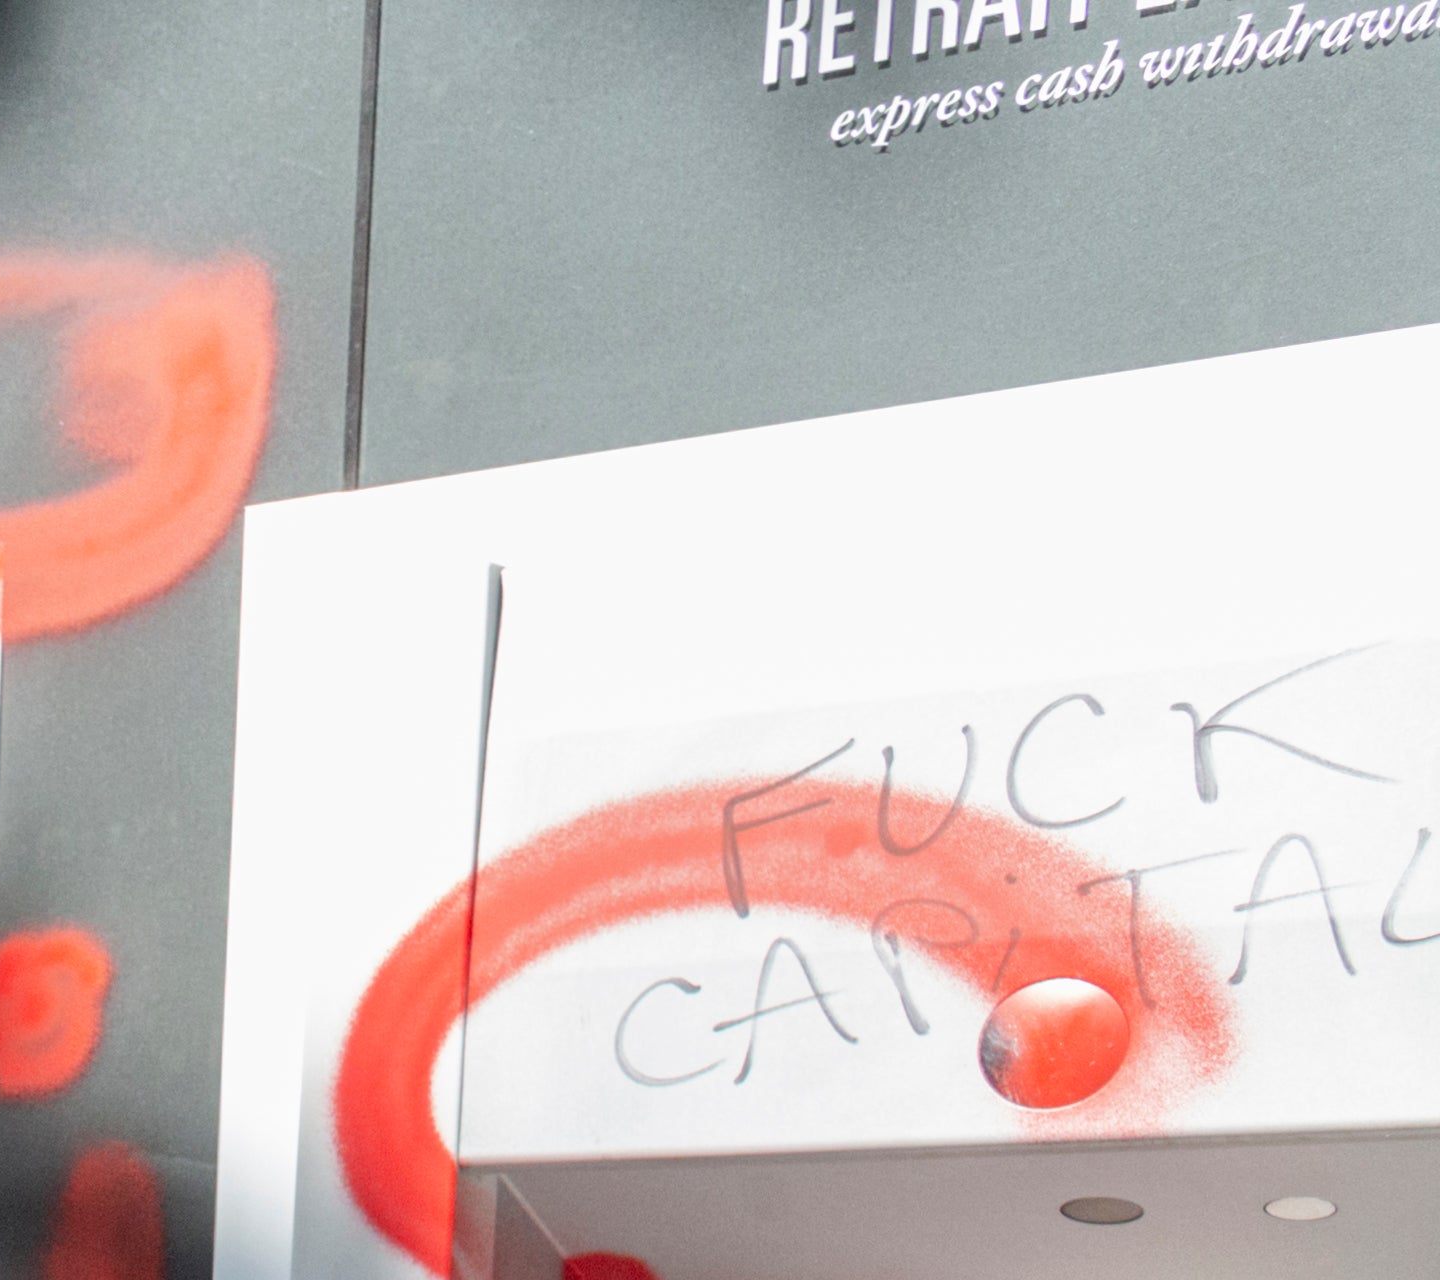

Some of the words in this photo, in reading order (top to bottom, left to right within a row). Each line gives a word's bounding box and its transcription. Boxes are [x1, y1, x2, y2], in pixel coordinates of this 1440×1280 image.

[829, 81, 1007, 148] express
[1014, 39, 1126, 107] cash
[1139, 0, 1440, 82] withdrawa
[721, 640, 1400, 918] FUCK
